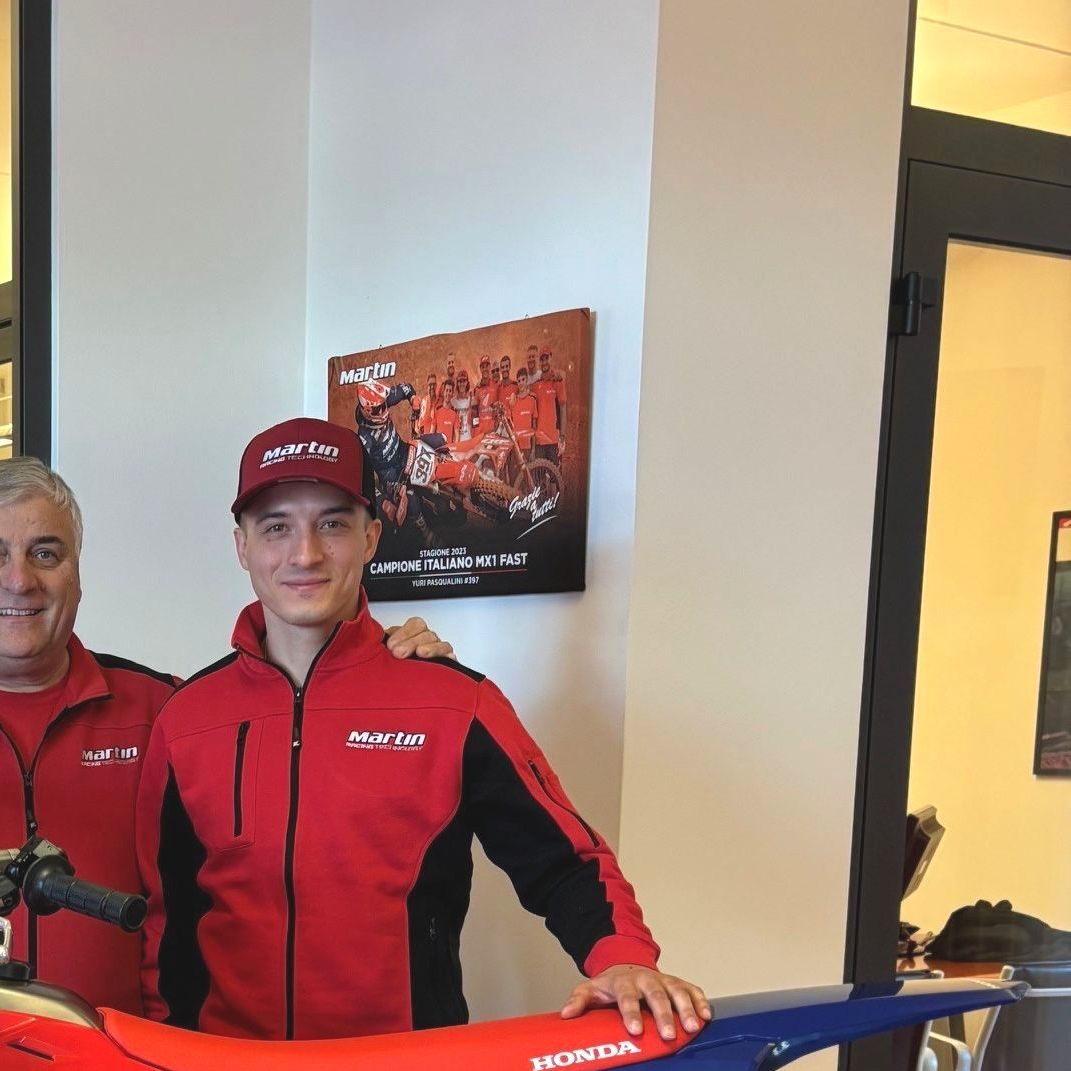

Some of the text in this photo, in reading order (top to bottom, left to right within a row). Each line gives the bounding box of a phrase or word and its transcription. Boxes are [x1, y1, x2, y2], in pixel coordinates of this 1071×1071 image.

[340, 361, 396, 385] Martin
[262, 441, 340, 462] Martin
[420, 547, 467, 558] STAGIONE 2023
[370, 552, 529, 574] CAMPIONE ITALIANO MX1 FAST
[412, 576, 480, 588] YURI PASQUALINI #397
[348, 731, 426, 746] Martin
[82, 747, 138, 760] Martin
[530, 1041, 641, 1071] HONDA
